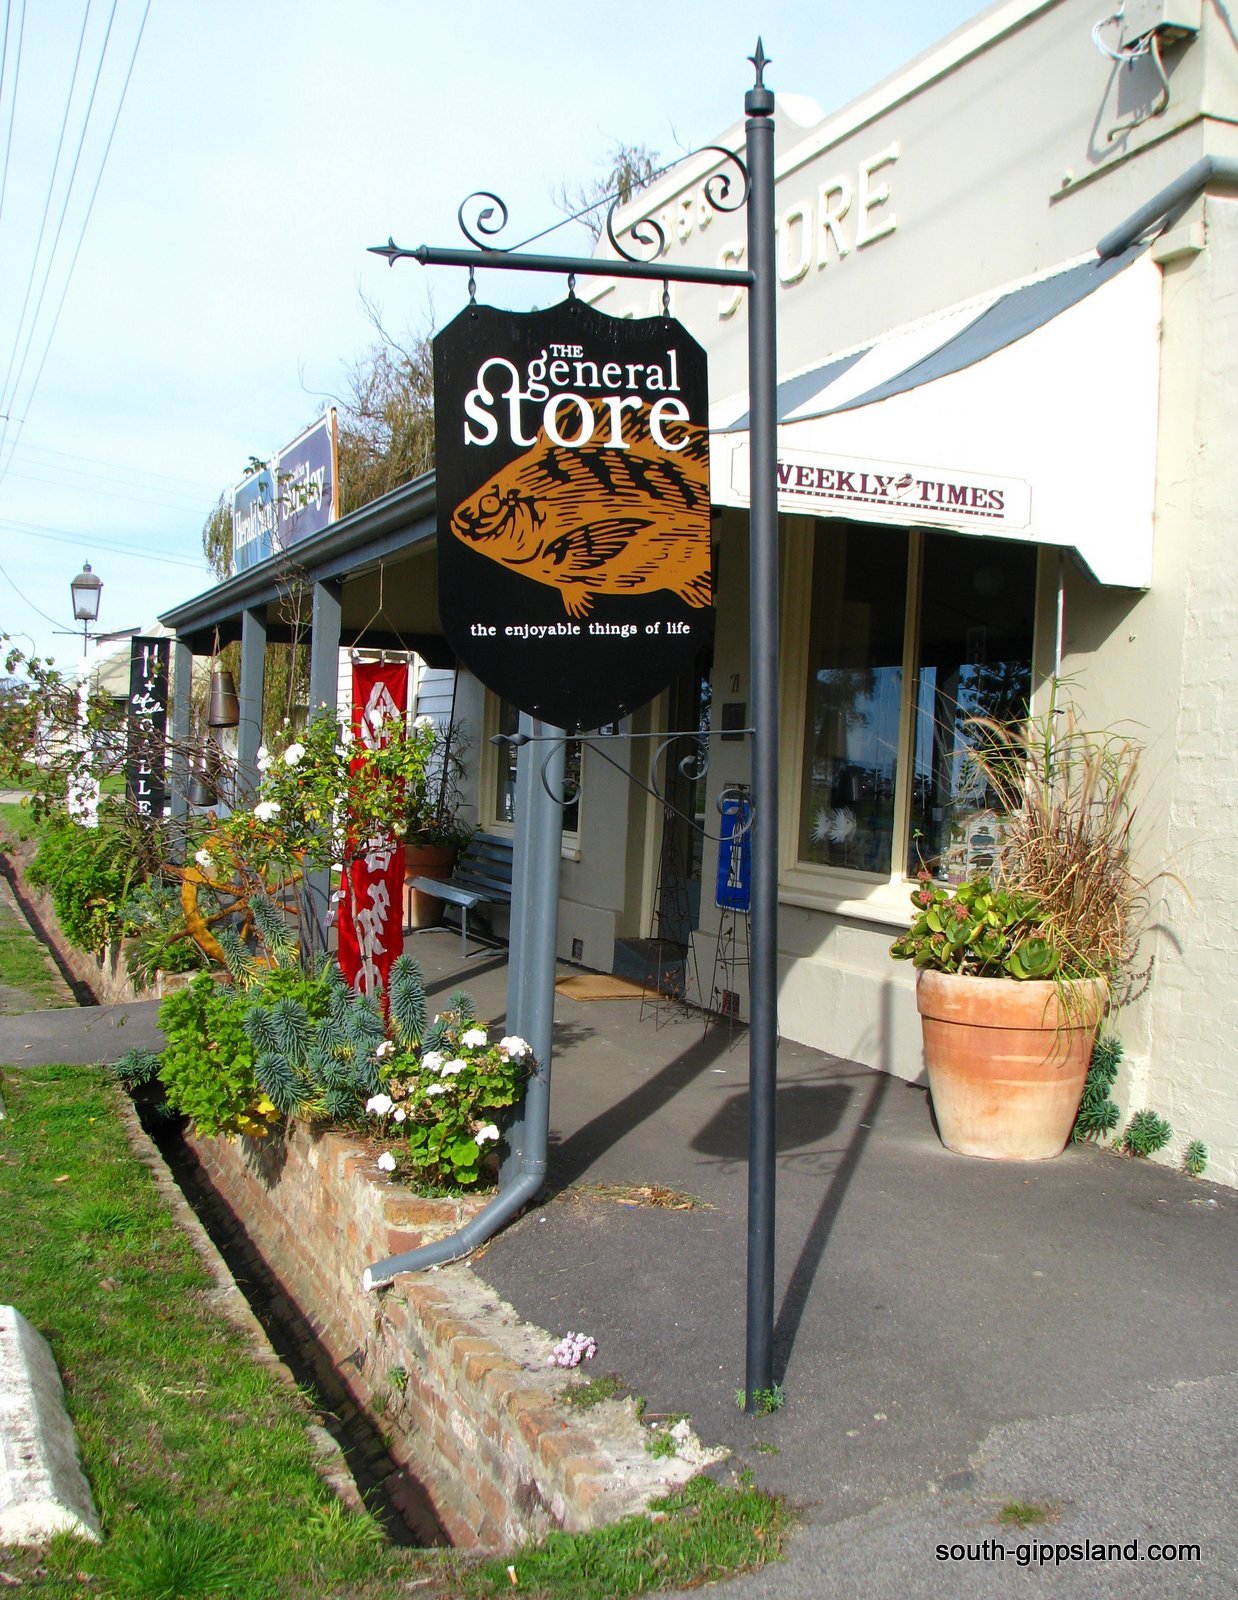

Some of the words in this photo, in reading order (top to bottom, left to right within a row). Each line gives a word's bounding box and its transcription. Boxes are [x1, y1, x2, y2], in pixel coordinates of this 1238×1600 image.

[550, 343, 583, 358] THE
[527, 349, 681, 402] general
[463, 357, 690, 451] store
[916, 480, 1005, 510] TIMES
[470, 623, 497, 637] the
[504, 622, 581, 639] enjoyable
[589, 622, 638, 638] things
[645, 621, 661, 635] of
[667, 621, 691, 635] life
